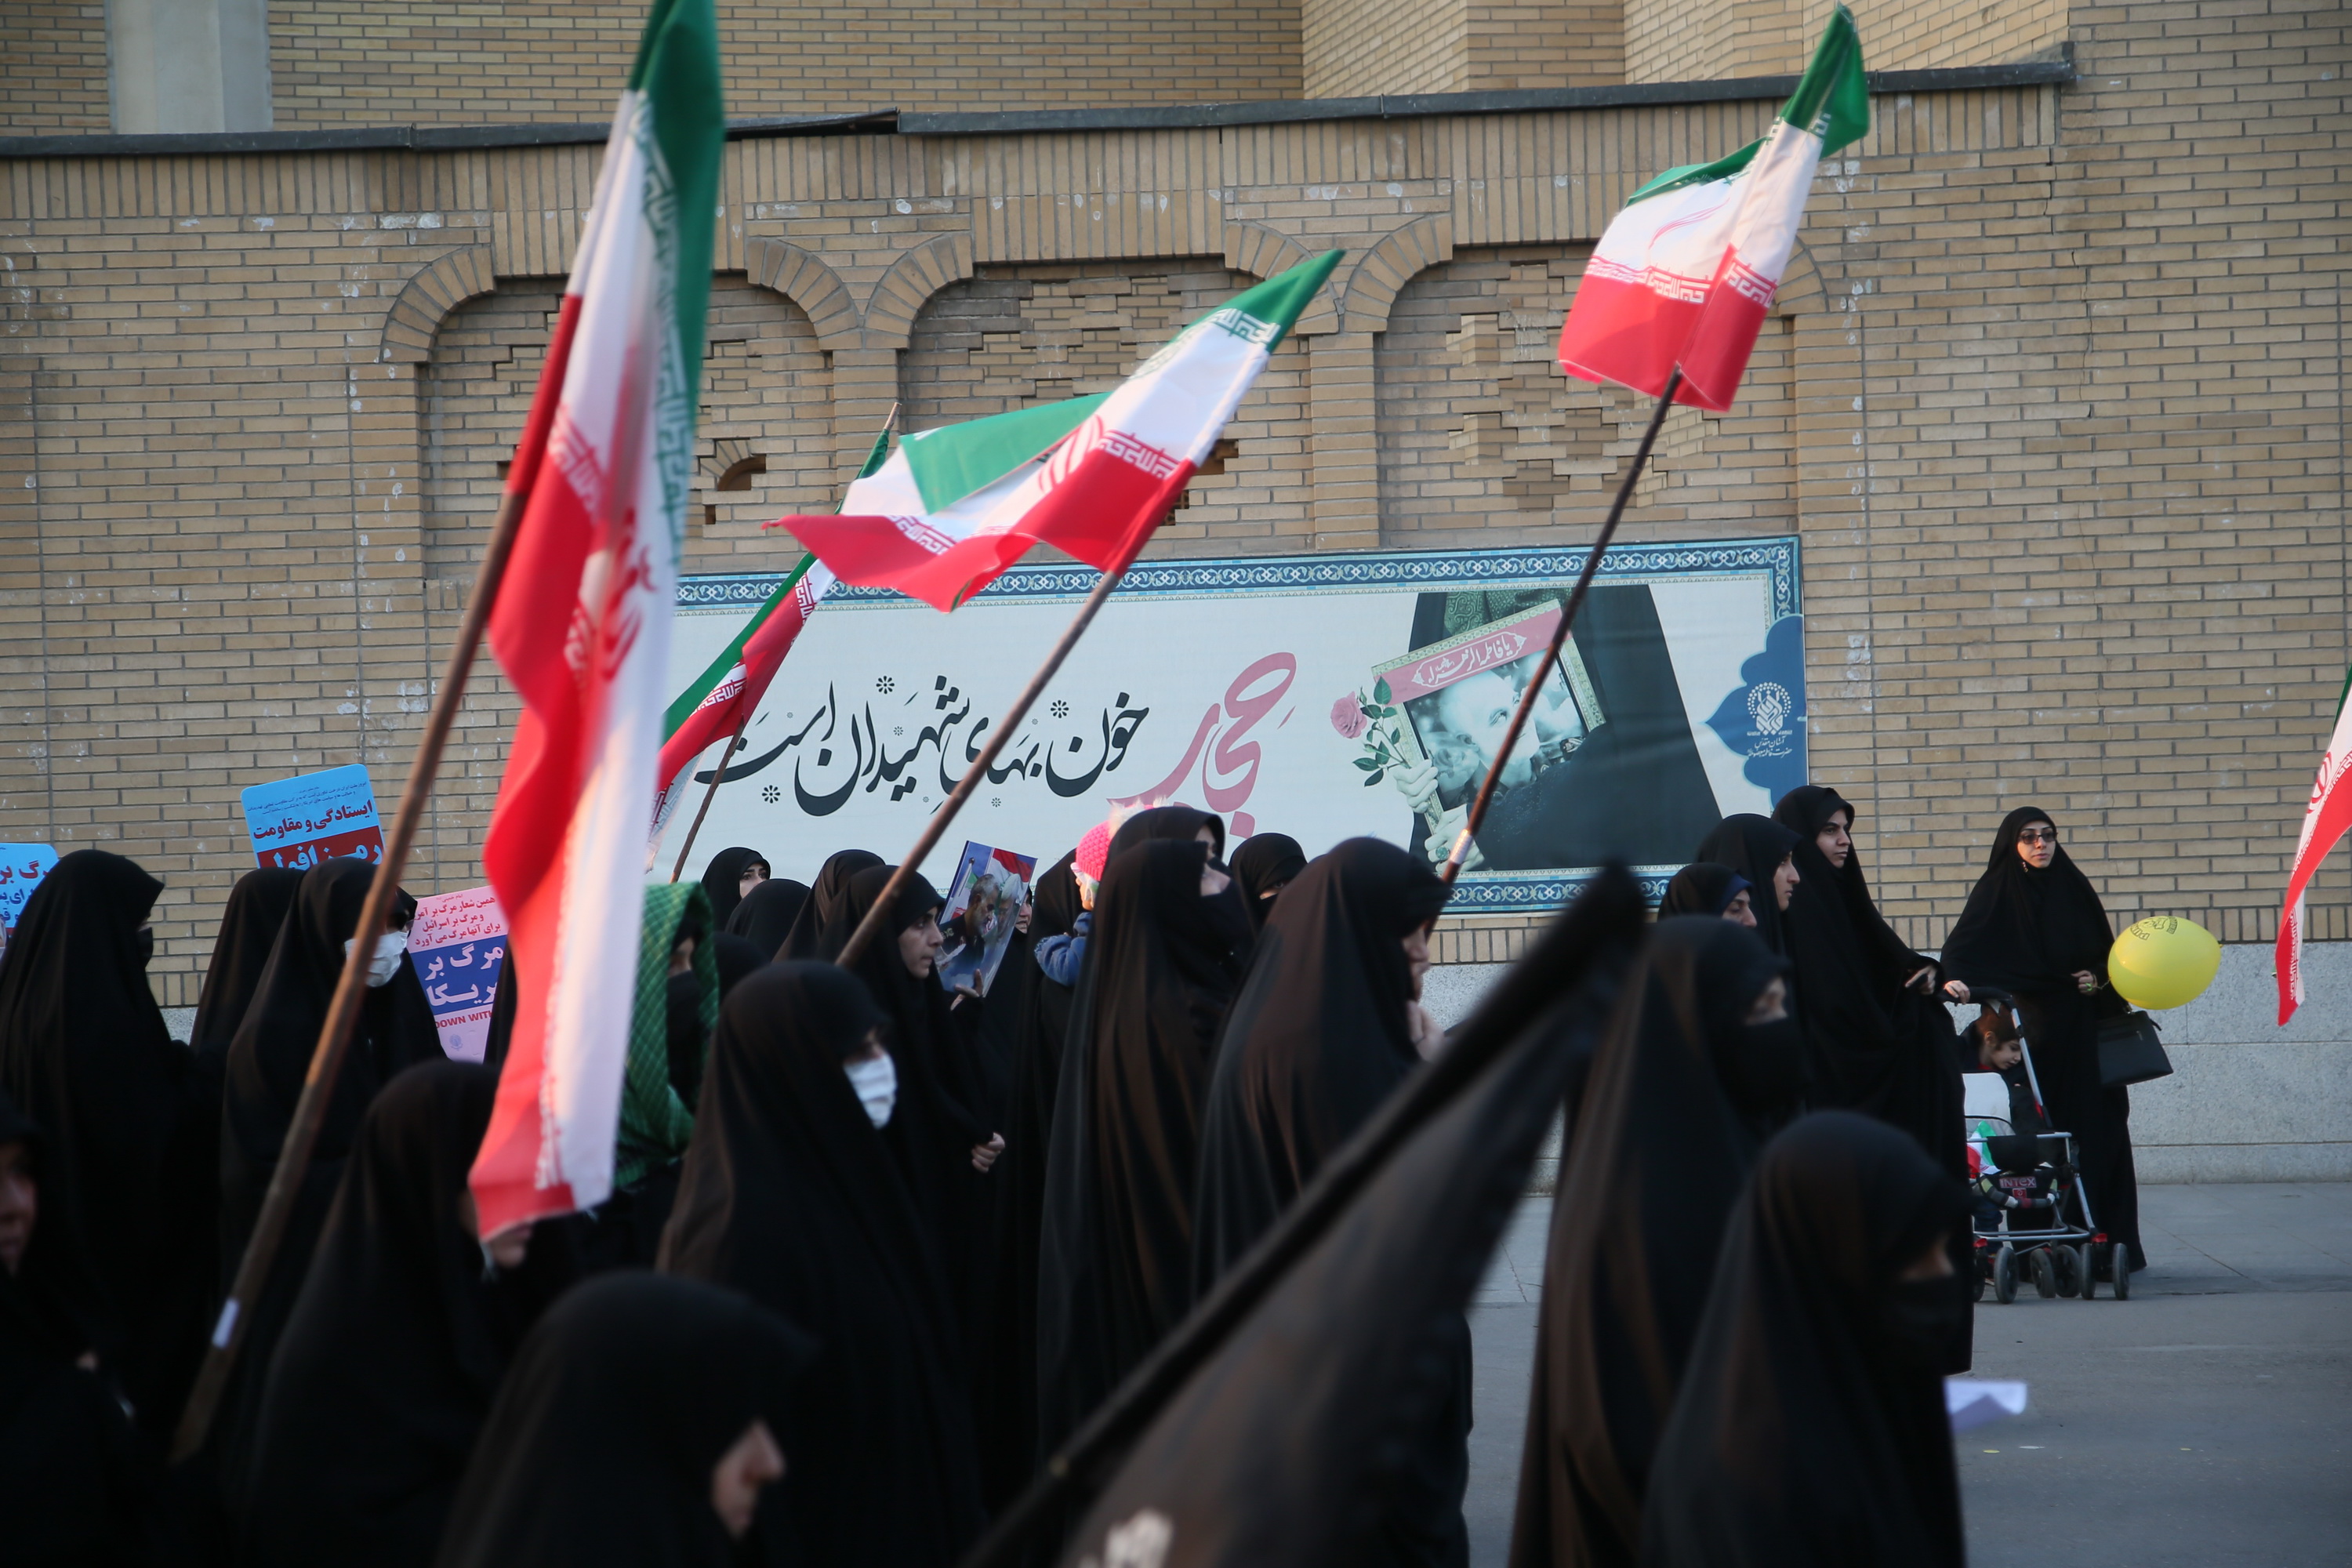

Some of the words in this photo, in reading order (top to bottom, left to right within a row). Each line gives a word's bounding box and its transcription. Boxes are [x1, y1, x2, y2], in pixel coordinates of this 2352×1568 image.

[1480, 640, 1504, 666] فاطمه
[1501, 634, 1513, 656] یا
[694, 680, 836, 785] است
[794, 675, 970, 816] شهیدان
[1047, 691, 1150, 797] خون
[929, 717, 1043, 815] بهی
[314, 800, 373, 829] ایستادگی
[253, 818, 303, 839] مقاومت
[306, 819, 312, 833] و
[438, 903, 457, 914] مرگ
[459, 899, 475, 912] شعار
[476, 897, 495, 908] همین
[431, 908, 438, 918] بر
[459, 914, 477, 924] مرگ
[423, 917, 450, 932] اسرائیل
[452, 918, 459, 927] بر
[466, 924, 481, 936] آنها
[483, 922, 501, 934] برای
[448, 930, 467, 939] مرگ
[449, 942, 503, 970] مرگ
[425, 955, 445, 981] بر
[426, 981, 498, 1007] ریکا
